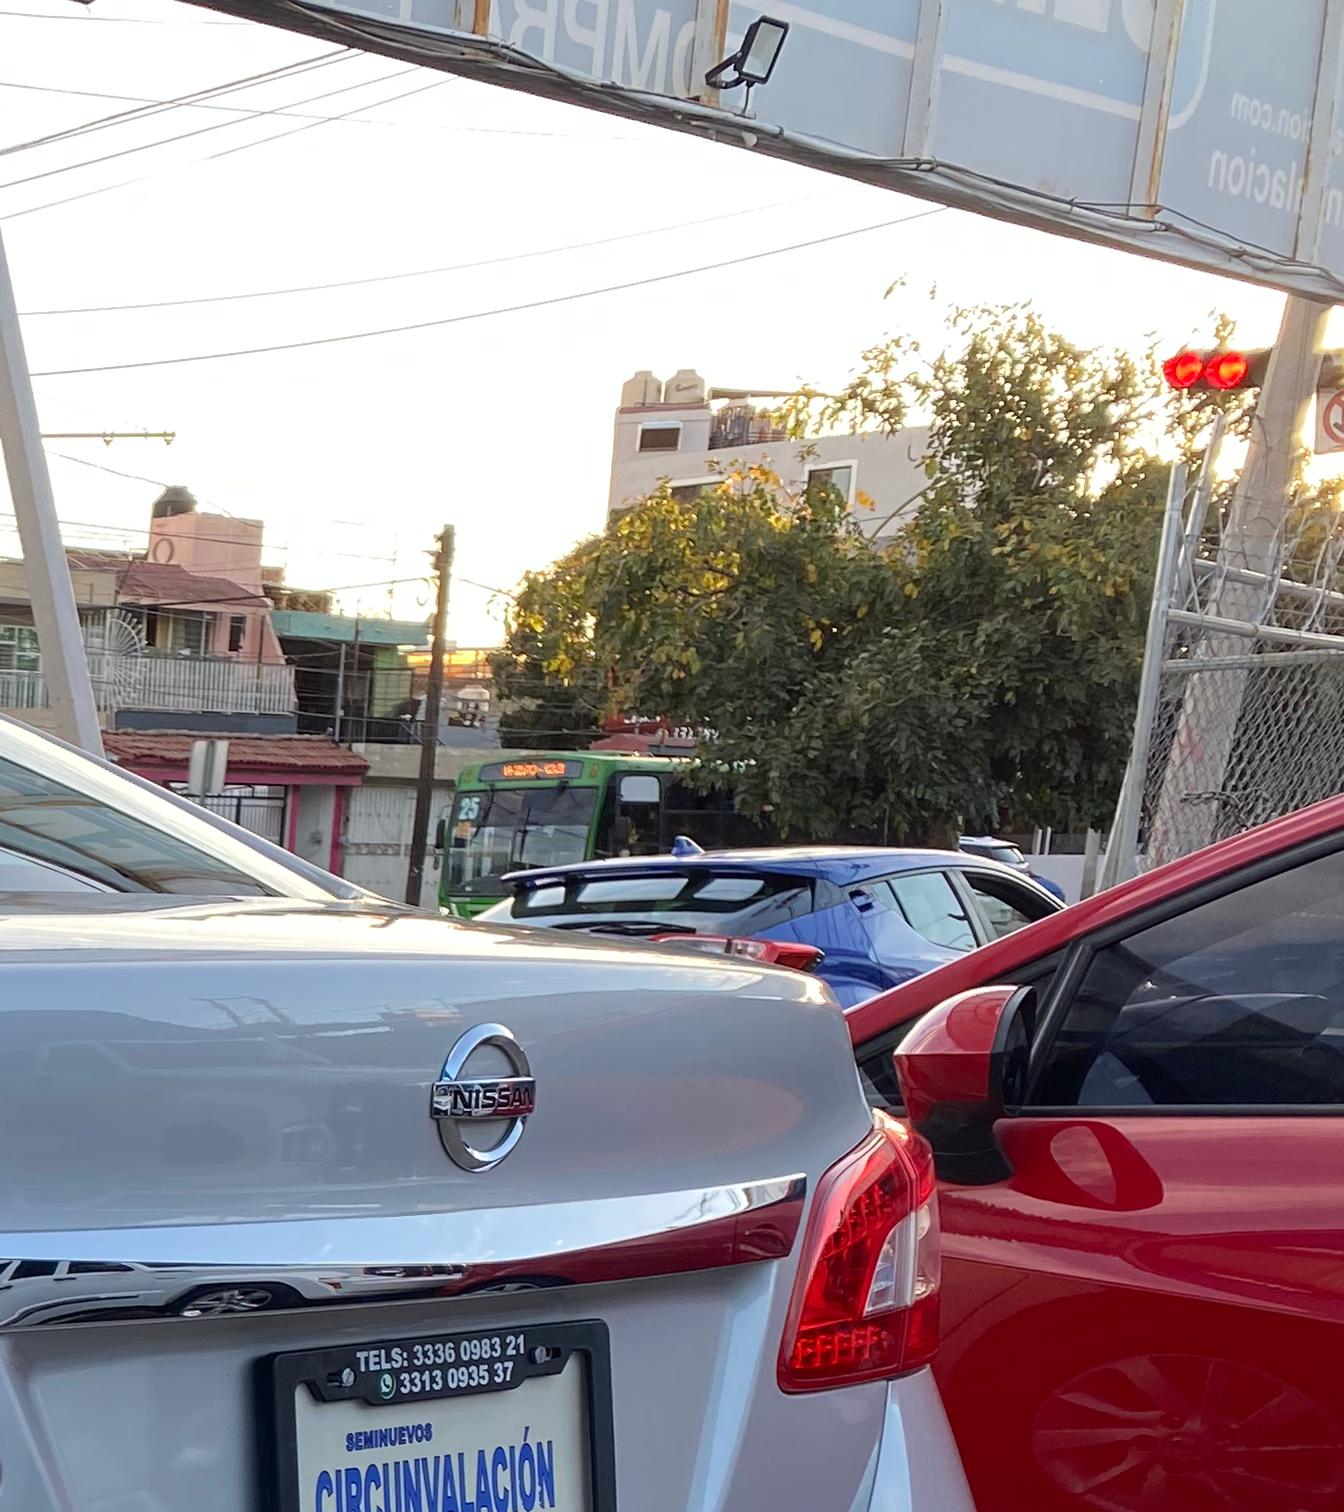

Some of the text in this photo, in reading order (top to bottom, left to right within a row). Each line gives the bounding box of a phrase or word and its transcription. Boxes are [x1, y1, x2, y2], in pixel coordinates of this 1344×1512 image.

[459, 797, 480, 820] 25
[453, 1085, 533, 1110] NISSAN
[356, 1334, 525, 1372] TELS: 3336 0983 21
[400, 1361, 514, 1394] 3313 0935 37
[346, 1422, 433, 1452] SEMINUEVOS
